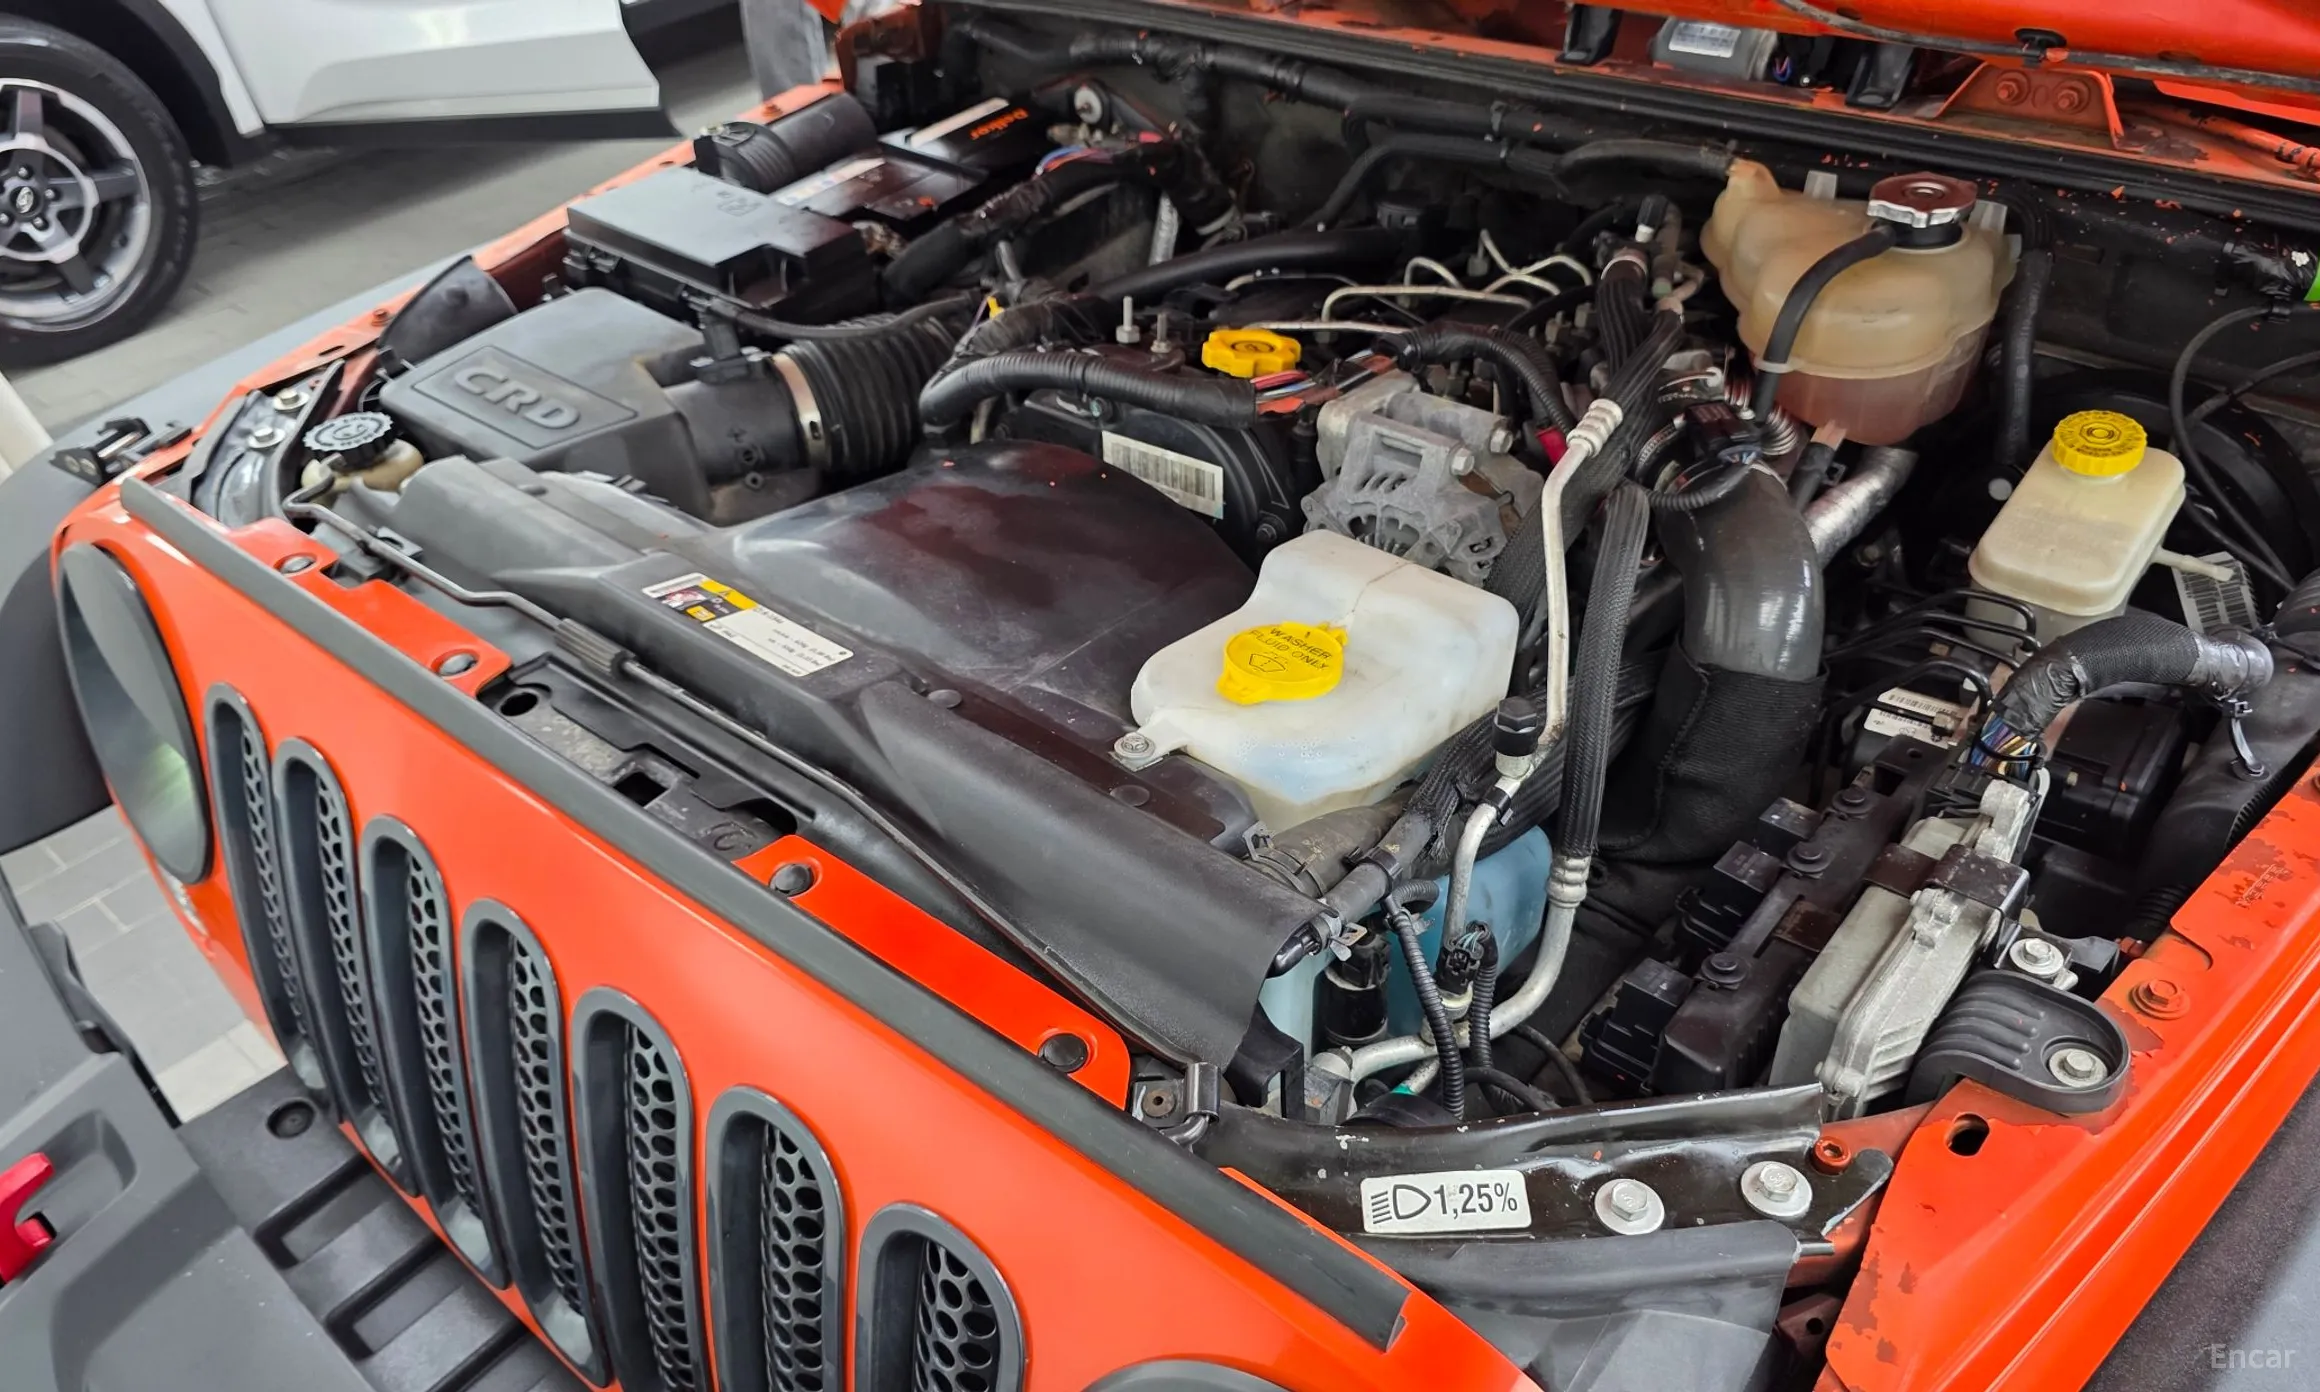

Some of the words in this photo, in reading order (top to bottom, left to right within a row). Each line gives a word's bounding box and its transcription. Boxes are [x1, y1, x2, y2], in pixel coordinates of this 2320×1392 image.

[454, 366, 580, 430] CRD
[1250, 629, 1290, 651] FLUID
[1291, 650, 1329, 670] ONLY
[1270, 628, 1332, 659] WASHER
[1433, 1182, 1518, 1219] 1,25%
